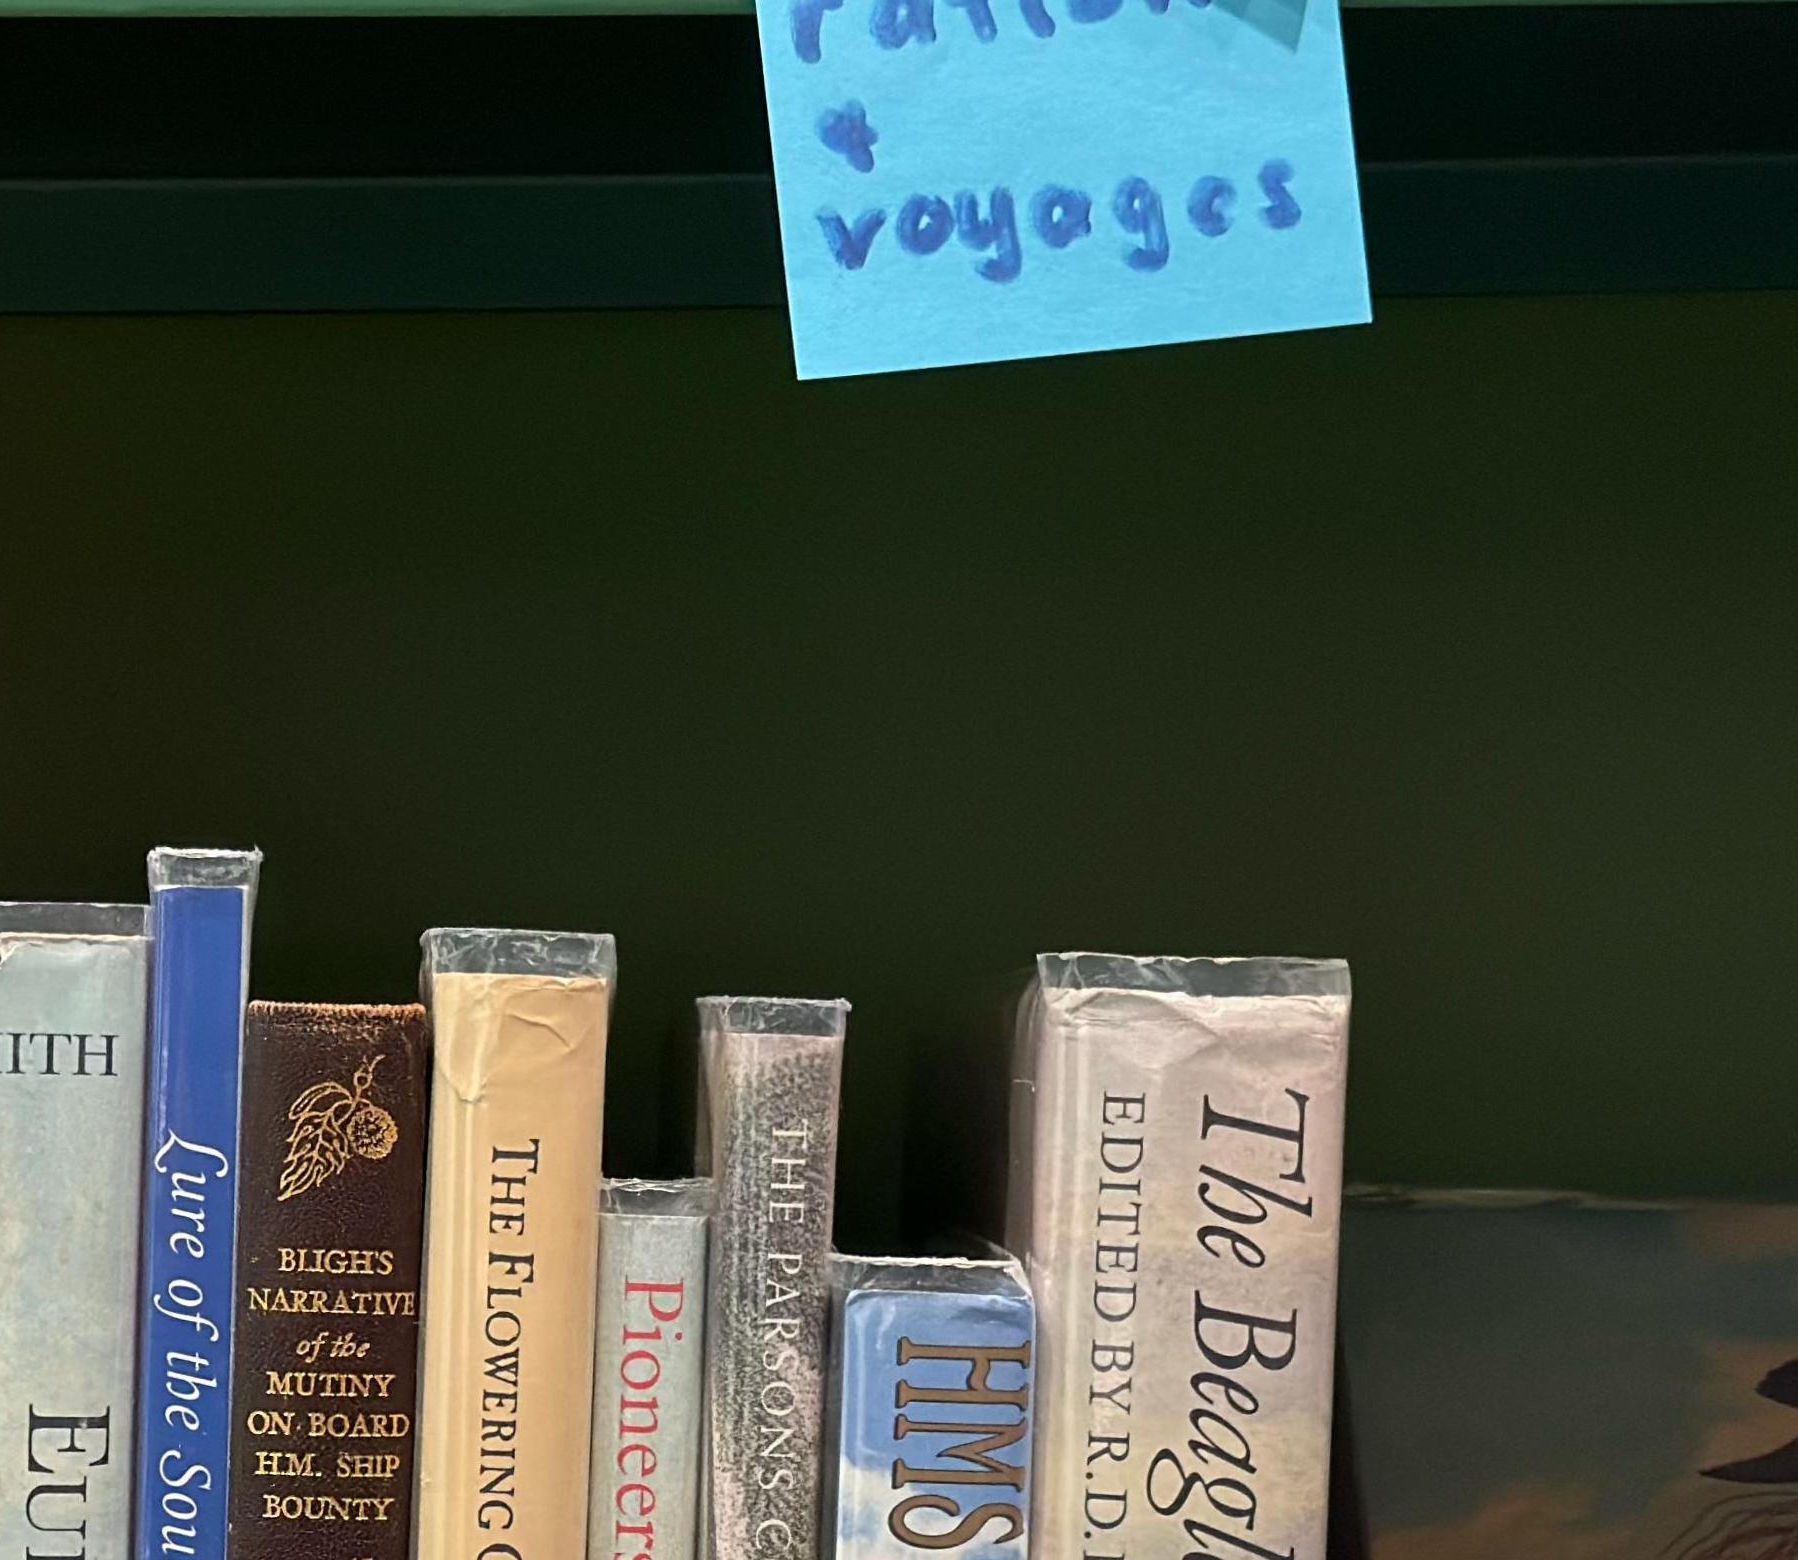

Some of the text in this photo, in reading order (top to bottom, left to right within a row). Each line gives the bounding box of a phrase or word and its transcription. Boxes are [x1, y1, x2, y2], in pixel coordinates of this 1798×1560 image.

[816, 158, 1302, 284] voyages
[154, 1130, 229, 1258] Lure
[488, 1138, 541, 1236] THE
[767, 1118, 809, 1223] THE
[1091, 1090, 1146, 1323] EDITED
[1196, 1087, 1314, 1270] The
[277, 1247, 394, 1276] BLIGH'S
[153, 1278, 219, 1342] of
[248, 1287, 416, 1316] NARRATIVE
[265, 1371, 396, 1397] MUTINY
[296, 1331, 371, 1364] of the
[756, 1252, 804, 1490] PARSONS
[1088, 1338, 1136, 1415] BY
[162, 1352, 218, 1431] the
[246, 1410, 410, 1438] ON BOARD
[477, 1251, 535, 1531] FLOWERING
[336, 1453, 401, 1478] SHIP
[888, 1336, 1032, 1551] HMS
[261, 1494, 395, 1521] BOUNTY
